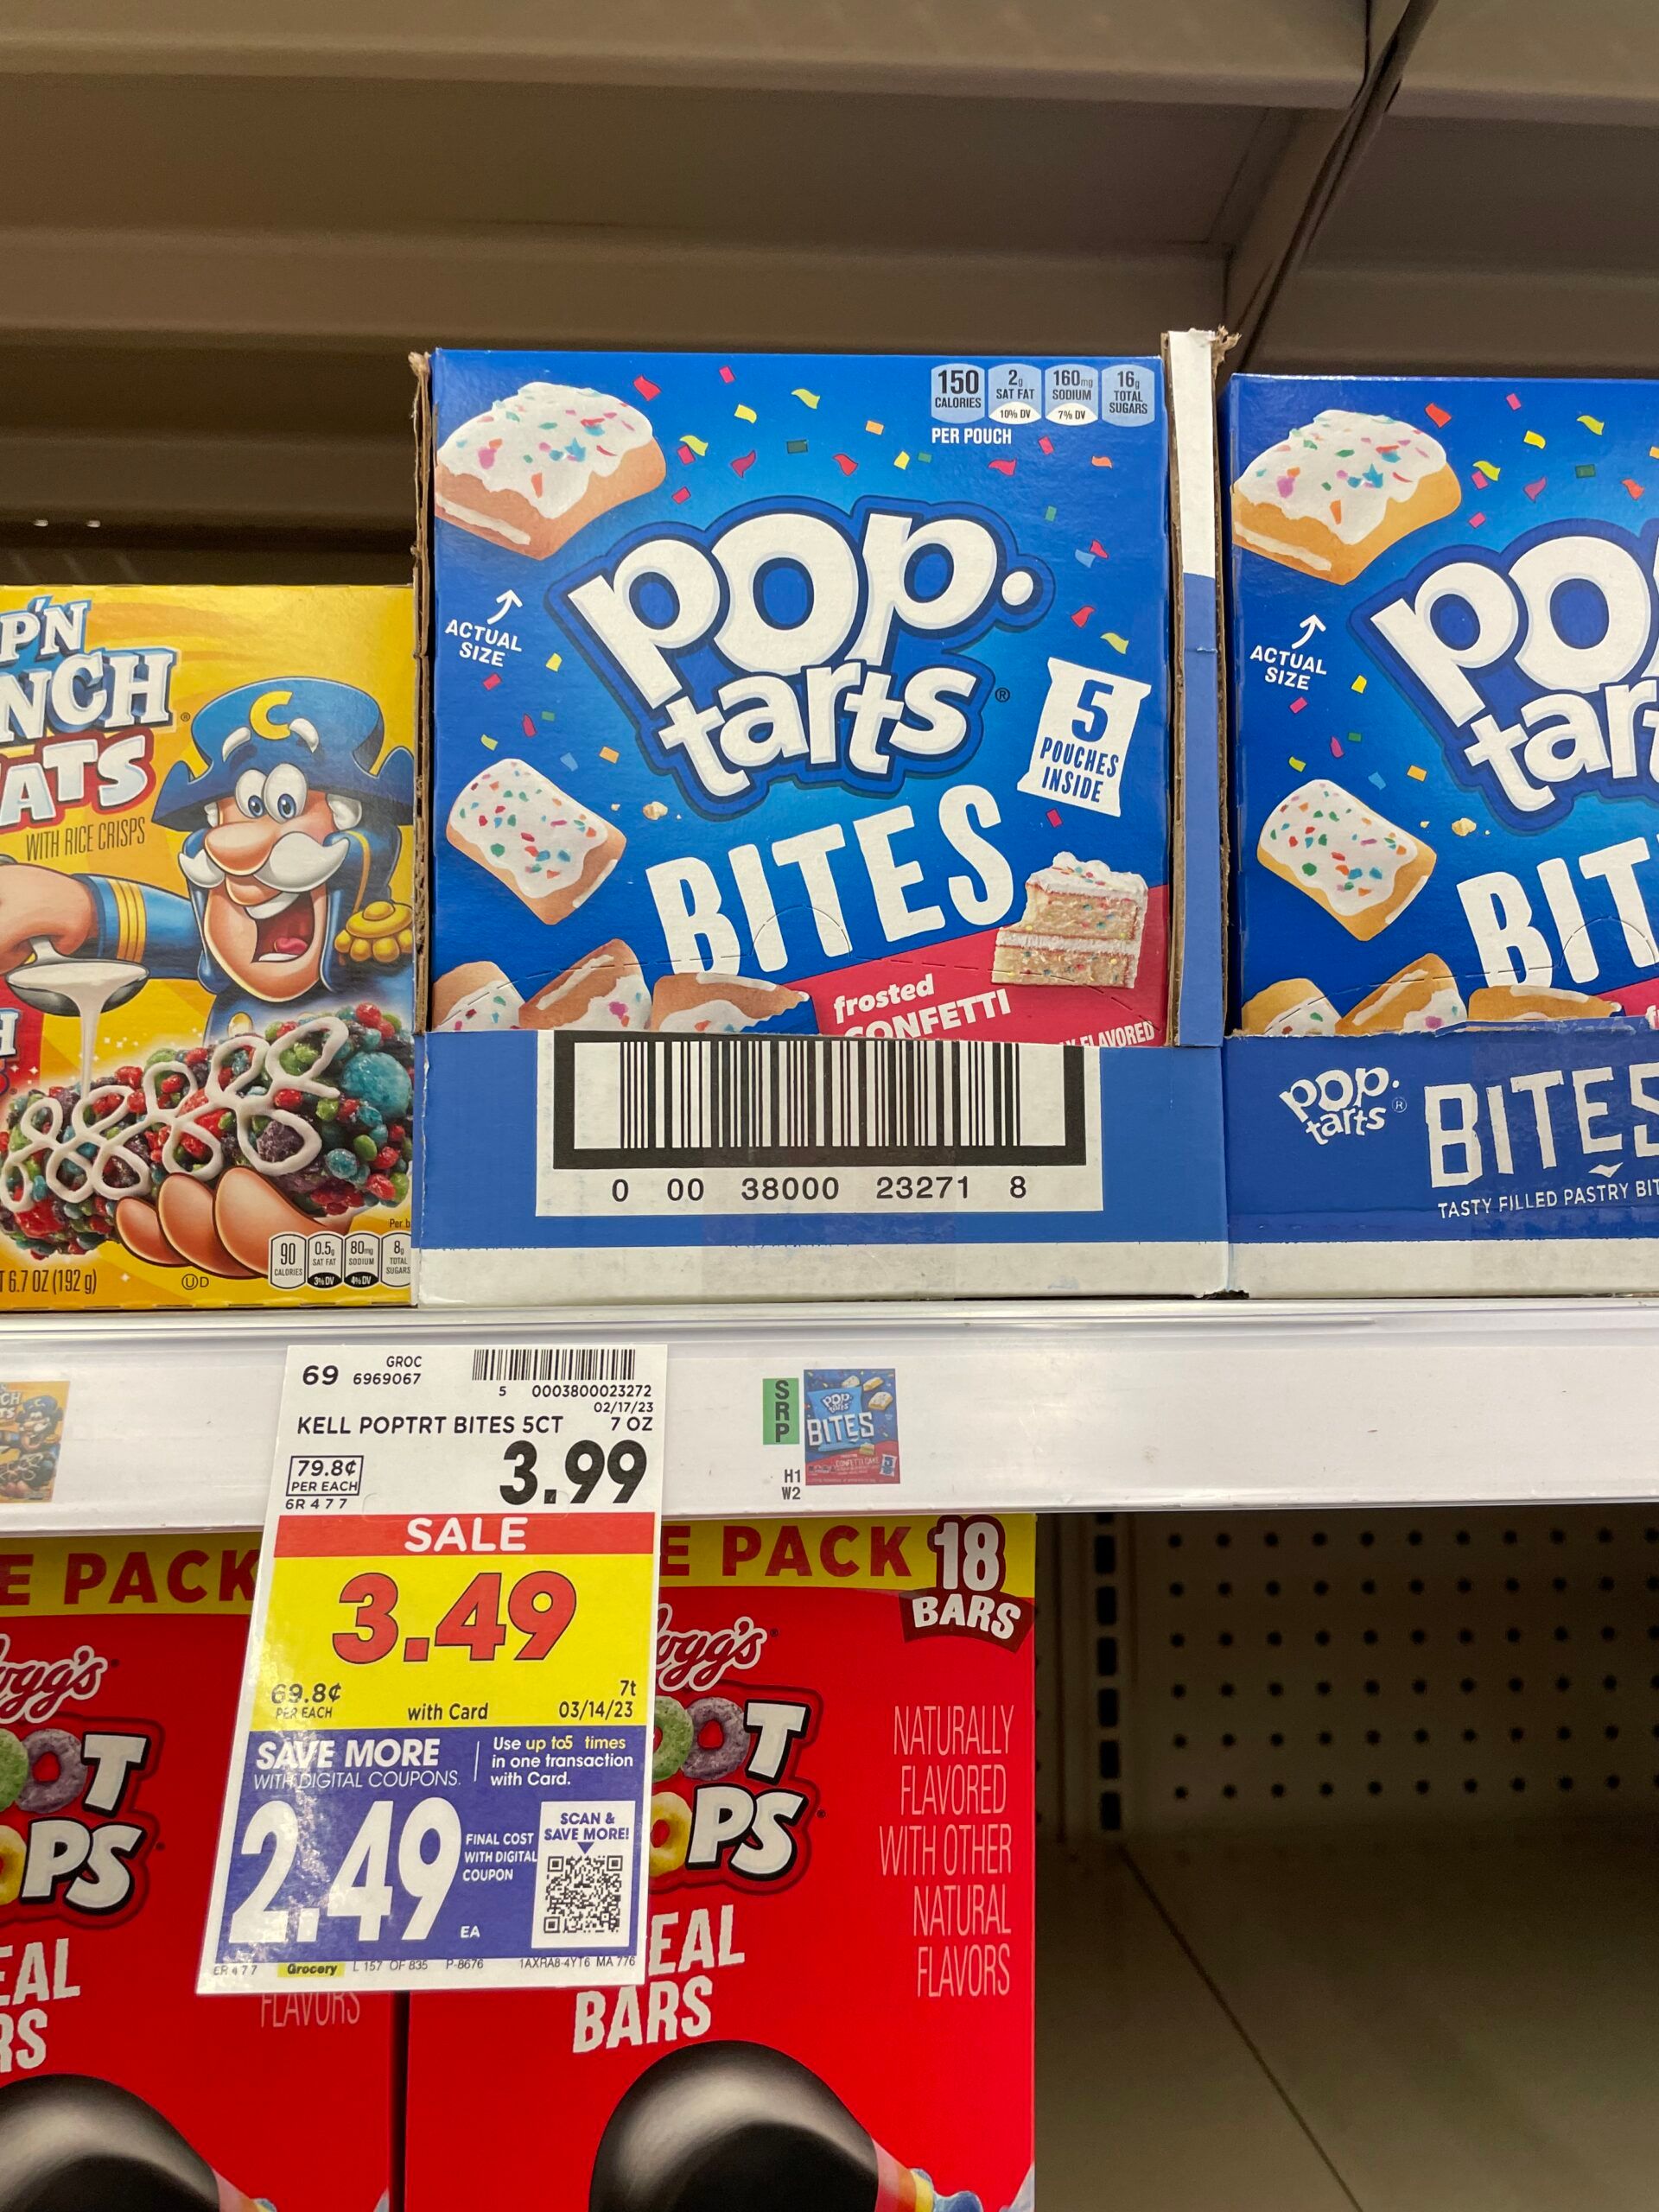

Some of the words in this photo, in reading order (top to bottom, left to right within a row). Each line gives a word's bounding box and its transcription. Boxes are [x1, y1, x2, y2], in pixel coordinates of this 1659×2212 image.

[938, 369, 980, 395] 150
[1052, 369, 1094, 388] 160mg
[934, 397, 982, 409] CALORIES
[995, 388, 1014, 400] SAT
[1017, 388, 1035, 400] FAT
[1052, 389, 1092, 401] SODIUM
[1113, 390, 1143, 403] TOTAL
[999, 409, 1018, 420] 10%
[1020, 409, 1032, 420] DV
[1058, 410, 1073, 421] 7%
[1075, 410, 1086, 421] DV
[1109, 402, 1148, 415] SUGARS
[931, 427, 960, 444] PER
[963, 427, 1012, 445] POUCH
[445, 619, 522, 652] ACTUAL
[459, 641, 505, 668] SIZE
[1249, 645, 1327, 676] ACTUAL
[1264, 666, 1311, 690] SIZE
[1071, 679, 1115, 743] 5
[658, 660, 978, 798] tarts
[1039, 736, 1119, 779] POUCHES
[1041, 766, 1104, 804] INSIDE
[26, 828, 60, 861] WITH
[64, 824, 94, 856] RICE
[98, 817, 145, 850] CRISPS
[645, 784, 1014, 976] BITES
[833, 973, 934, 1024] frosted
[1306, 1105, 1386, 1146] tarts
[611, 1177, 630, 1201] 0
[666, 1177, 705, 1201] 00
[741, 1176, 840, 1200] 38000
[876, 1175, 969, 1198] 23271
[1010, 1175, 1027, 1198] 8
[1438, 1198, 1492, 1219] TASTY
[1499, 1191, 1558, 1212] FILLED
[1564, 1182, 1629, 1205] PASTRY
[389, 1218, 402, 1229] Per
[281, 1243, 296, 1265] 90
[348, 1257, 374, 1266] SODIUM
[274, 1268, 302, 1276] CALORIES
[385, 1266, 410, 1274] SUGARS
[9, 1269, 28, 1293] 6.7
[32, 1269, 48, 1293] OZ
[53, 1269, 80, 1294] (192
[85, 1268, 97, 1294] g)
[326, 1277, 334, 1286] DV
[362, 1276, 372, 1285] DV
[386, 1356, 423, 1368] GROC
[302, 1365, 339, 1385] 69
[353, 1372, 422, 1385] 6969067
[499, 1385, 506, 1396] 5
[531, 1384, 652, 1398] 0003800023272
[593, 1402, 654, 1414] 02/17/23
[297, 1417, 351, 1434] KELL
[359, 1416, 447, 1434] POPTRT
[454, 1416, 516, 1433] BITES
[522, 1415, 563, 1433] 5CT
[611, 1417, 620, 1431] 7
[626, 1417, 653, 1431] OZ
[807, 1412, 874, 1446] BITES
[298, 1459, 356, 1477] 79.8¢
[499, 1440, 647, 1505] 3.99
[785, 1469, 801, 1483] H1
[291, 1481, 317, 1491] PER
[321, 1481, 358, 1491] EACH
[782, 1486, 801, 1500] W2
[404, 1517, 528, 1552] SALE
[722, 1525, 912, 1577] PACK
[934, 1522, 1000, 1592] 18
[64, 1549, 259, 1605] PACK
[332, 1571, 577, 1664] 3.49
[912, 1593, 1021, 1639] BARS
[276, 1707, 298, 1719] PER
[302, 1707, 333, 1719] EACH
[408, 1705, 444, 1720] with
[449, 1704, 488, 1719] Card
[558, 1701, 633, 1719] 03/14/23
[893, 1705, 1014, 1756] NATURALLY
[493, 1737, 521, 1751] Use
[526, 1738, 546, 1753] up
[585, 1736, 626, 1751] times
[257, 1740, 335, 1770] SAVE
[346, 1739, 440, 1768] MORE
[493, 1757, 506, 1769] in
[512, 1758, 541, 1769] one
[546, 1753, 633, 1768] transaction
[254, 1773, 295, 1789] WITH
[297, 1770, 363, 1789] DIGITAL
[368, 1770, 461, 1788] COUPONS.
[491, 1774, 522, 1787] with
[528, 1770, 571, 1787] Card.
[901, 1764, 1007, 1815] FLAVORED
[560, 1812, 601, 1825] SCAN
[605, 1812, 615, 1824] &
[466, 1834, 499, 1845] FINAL
[503, 1833, 534, 1845] COST
[544, 1827, 578, 1840] SAVE
[583, 1827, 629, 1840] MORE!
[465, 1852, 493, 1863] WITH
[495, 1851, 537, 1863] DIGITAL
[880, 1825, 936, 1876] WITH
[944, 1823, 1012, 1876] OTHER
[228, 1797, 461, 1943] 2.49
[462, 1869, 513, 1881] COUPON
[913, 1884, 1011, 1936] NATURAL
[461, 1926, 480, 1938] EA
[287, 1963, 338, 1976] Grocery
[364, 1961, 383, 1971] 157
[390, 1961, 405, 1971] OF
[409, 1961, 429, 1970] 835
[446, 1959, 484, 1970] P-8676
[596, 1956, 613, 1967] MA
[616, 1955, 636, 1967] 776
[918, 1943, 1010, 1998] FLAVORS
[573, 1975, 713, 2053] BARS
